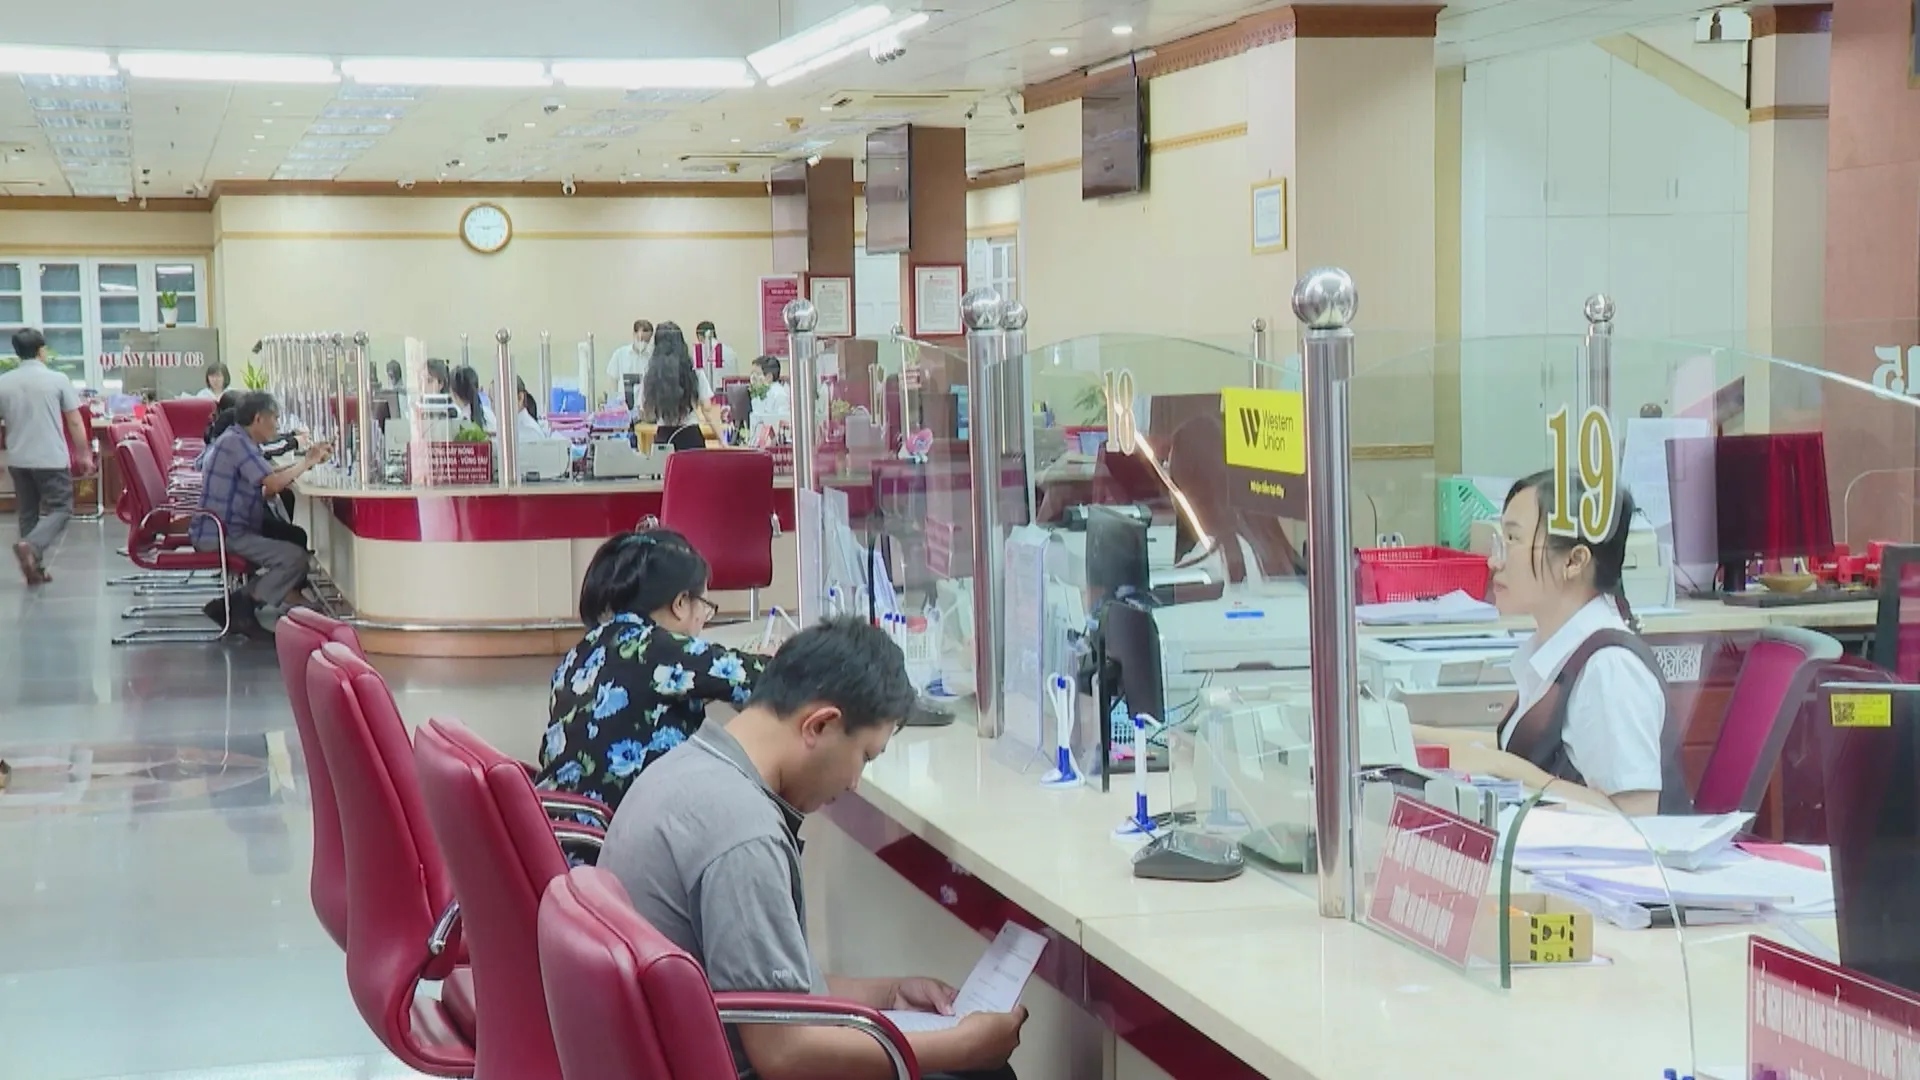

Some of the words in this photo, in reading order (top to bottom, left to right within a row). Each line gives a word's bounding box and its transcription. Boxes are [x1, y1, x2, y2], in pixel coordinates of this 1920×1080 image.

[147, 351, 181, 367] THU
[1101, 369, 1136, 455] 18
[1262, 409, 1294, 433] Western
[1263, 431, 1286, 452] Union
[1547, 404, 1616, 544] 19
